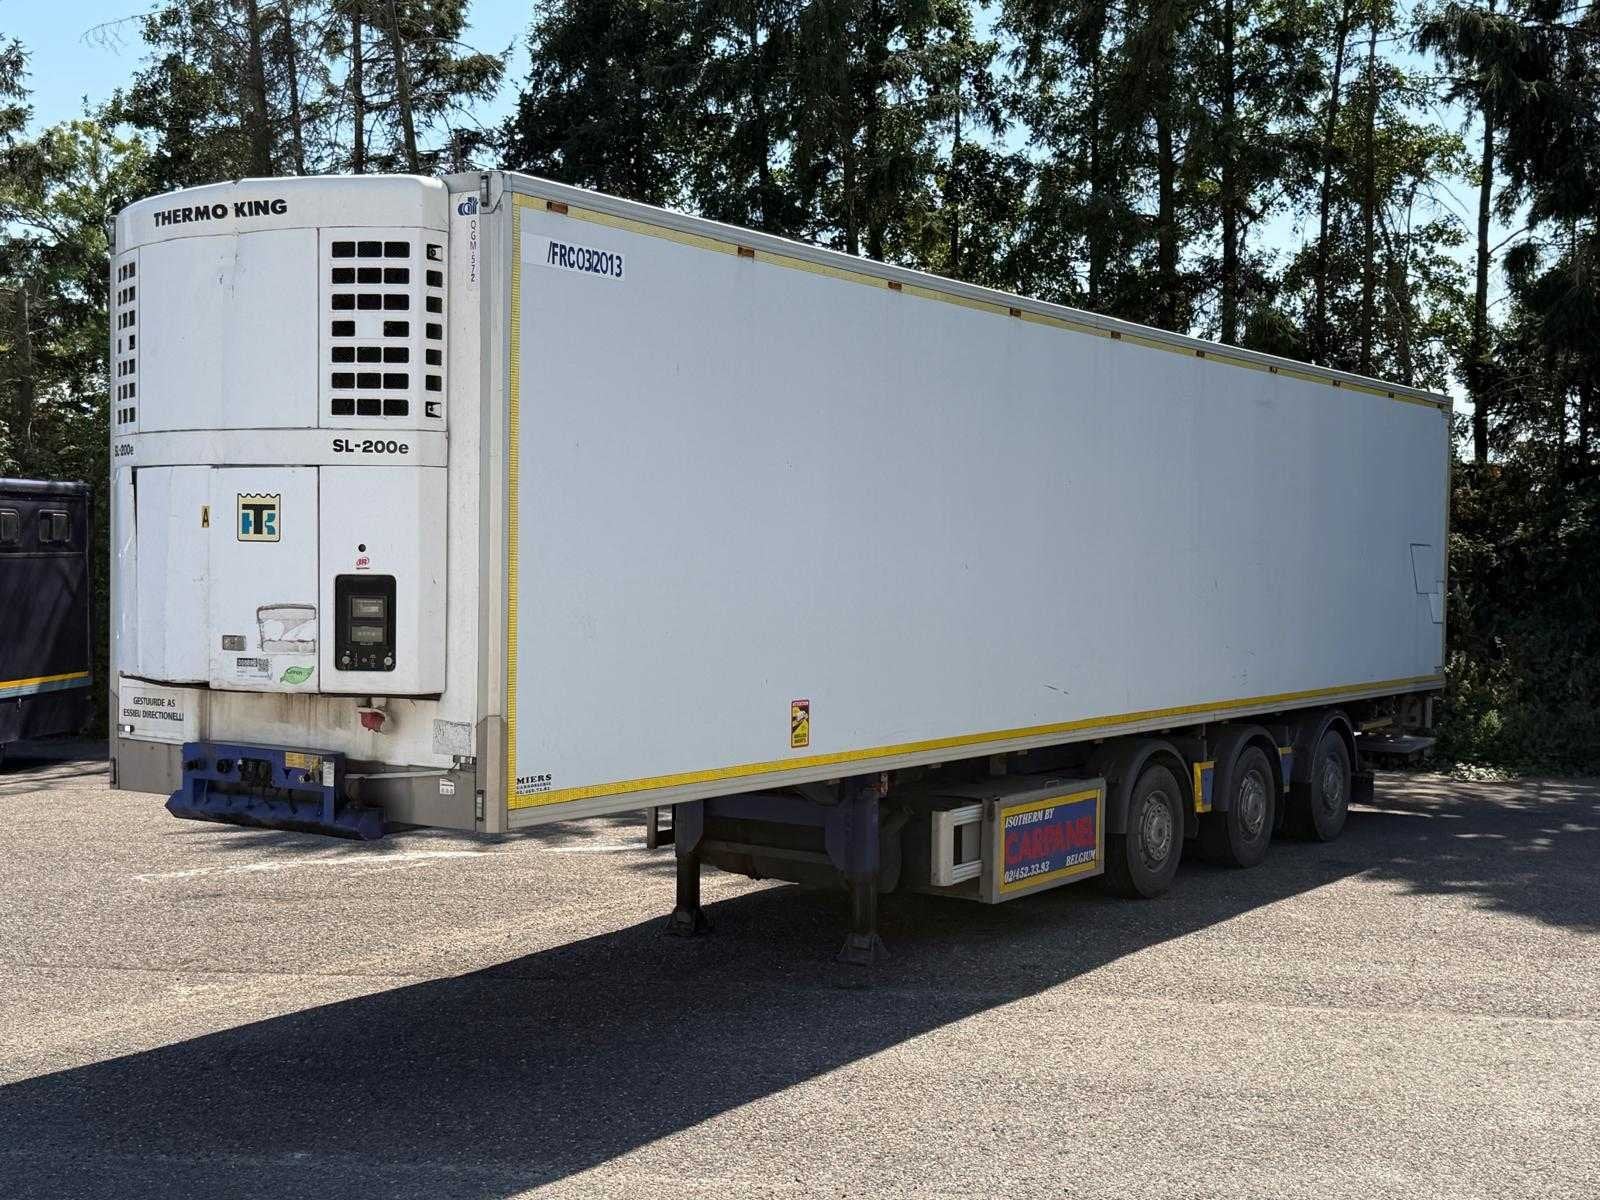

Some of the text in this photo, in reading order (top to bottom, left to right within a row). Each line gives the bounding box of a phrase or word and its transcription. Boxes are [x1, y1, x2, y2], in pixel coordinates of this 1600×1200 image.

[153, 199, 288, 227] THERMO KING
[332, 439, 409, 455] SL-200e
[133, 696, 176, 708] GESTUURDE AS
[123, 708, 142, 718] ESSIEU
[1005, 808, 1055, 829] ISOTHERM BY
[1065, 848, 1097, 867] BELGIUM
